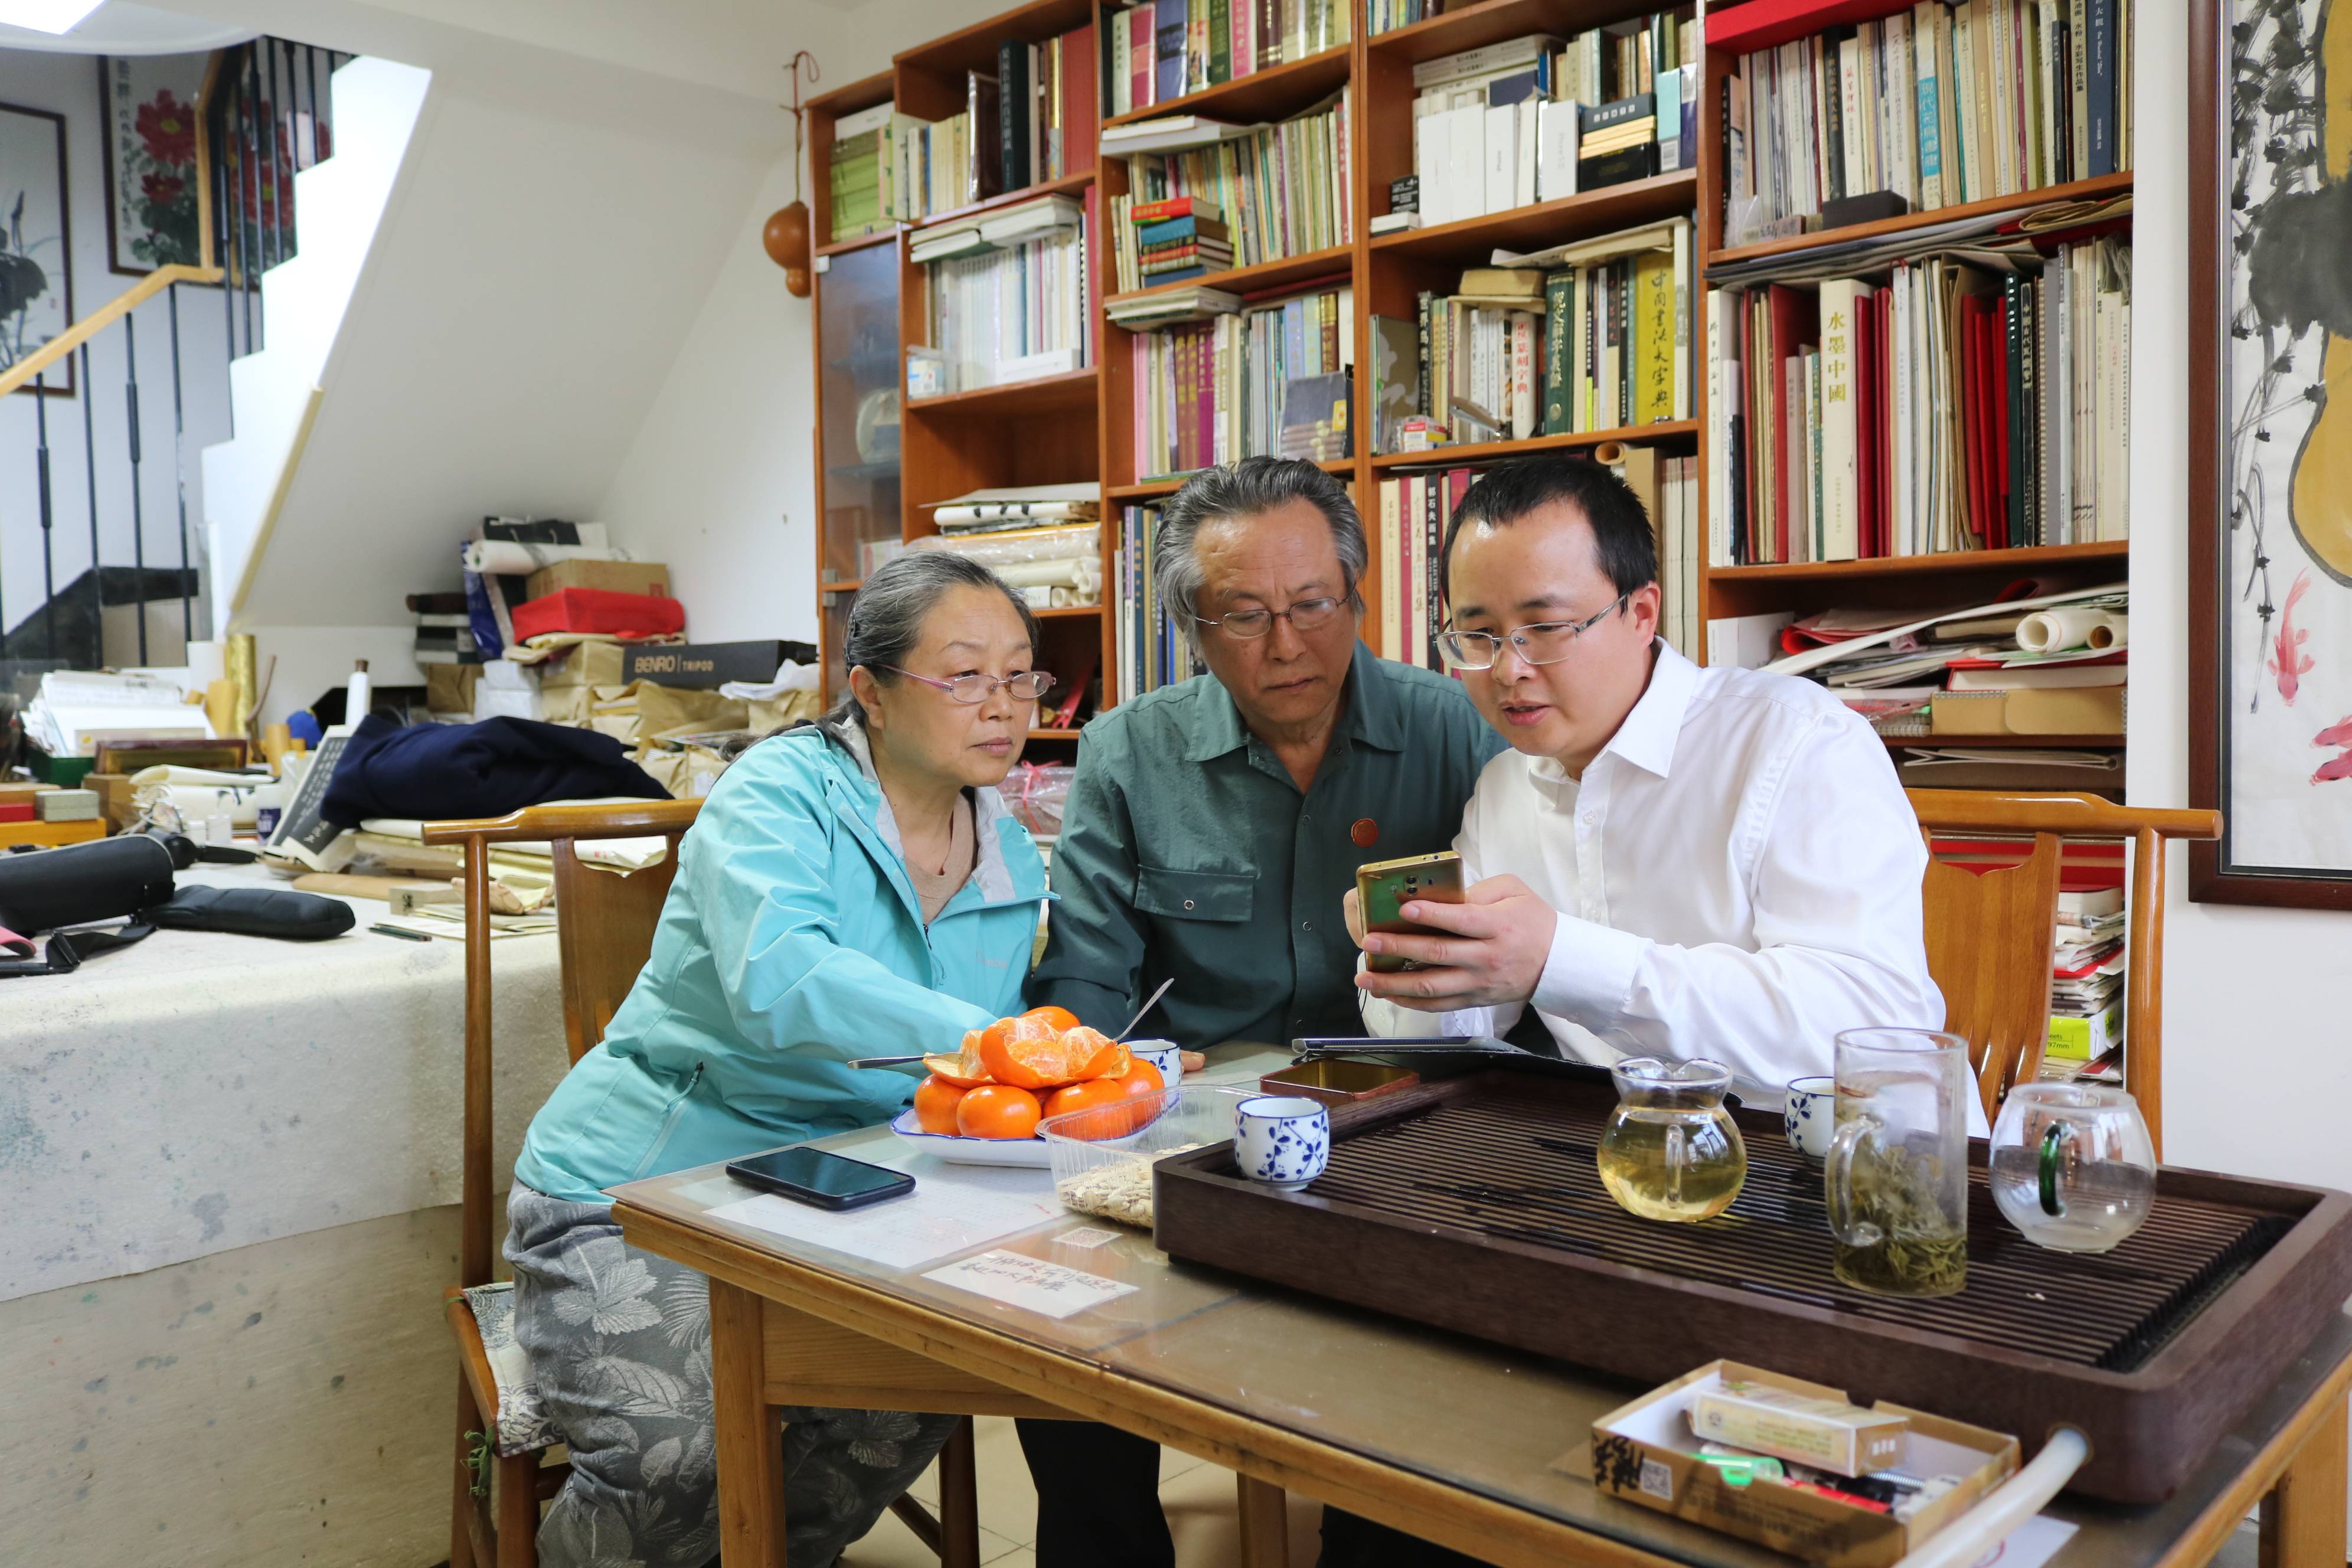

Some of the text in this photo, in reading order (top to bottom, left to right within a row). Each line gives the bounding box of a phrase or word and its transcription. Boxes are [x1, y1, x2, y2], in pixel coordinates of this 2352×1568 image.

[1828, 311, 1846, 403] 水墨中國
[634, 655, 714, 674] BENRO TRIPOD
